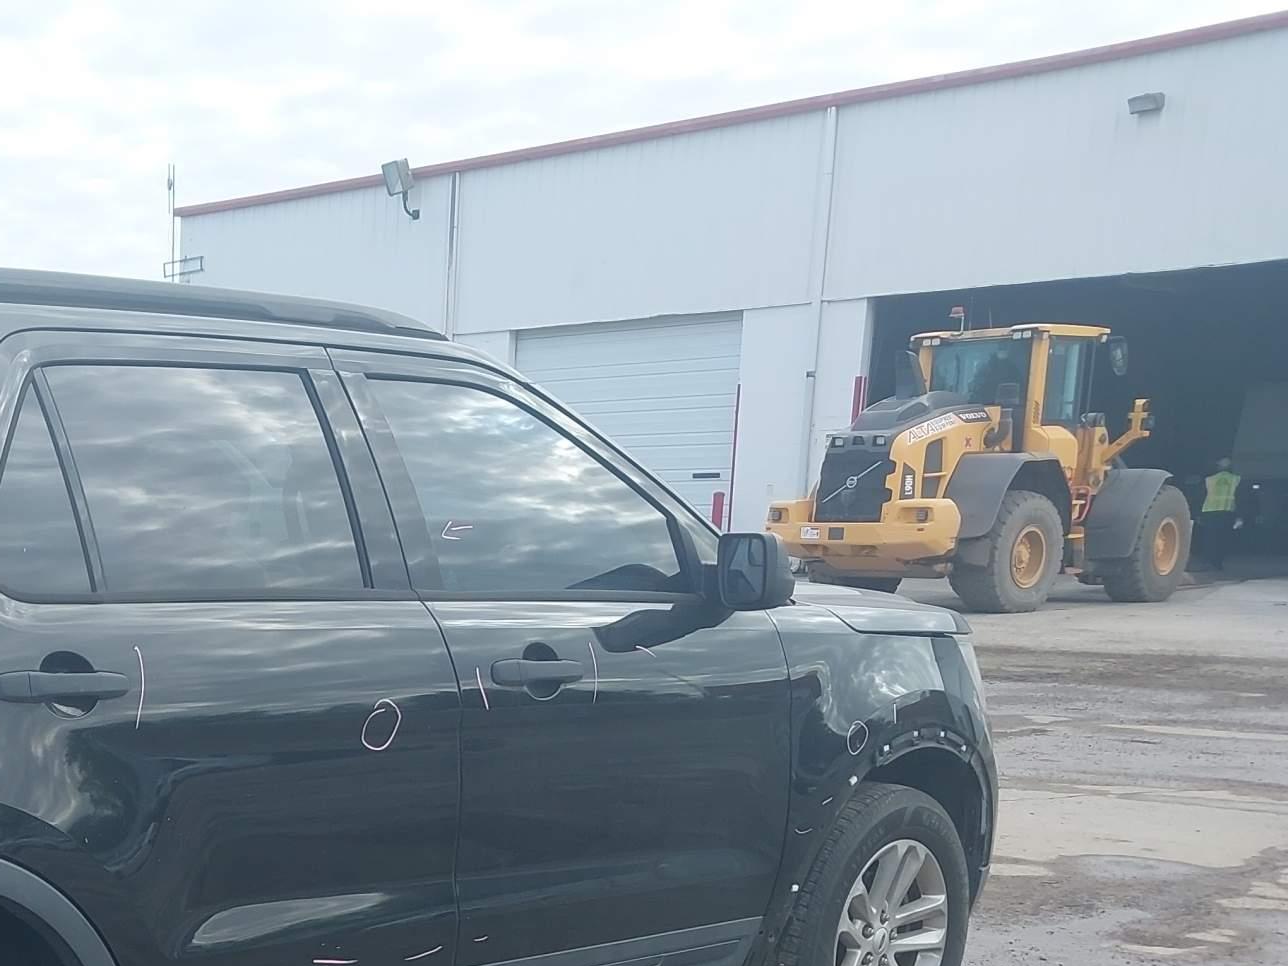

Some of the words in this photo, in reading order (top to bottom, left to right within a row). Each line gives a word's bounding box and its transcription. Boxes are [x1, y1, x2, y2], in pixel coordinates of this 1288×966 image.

[958, 411, 987, 420] VOLVO
[908, 421, 937, 444] ALTA
[904, 474, 914, 495] L90H
